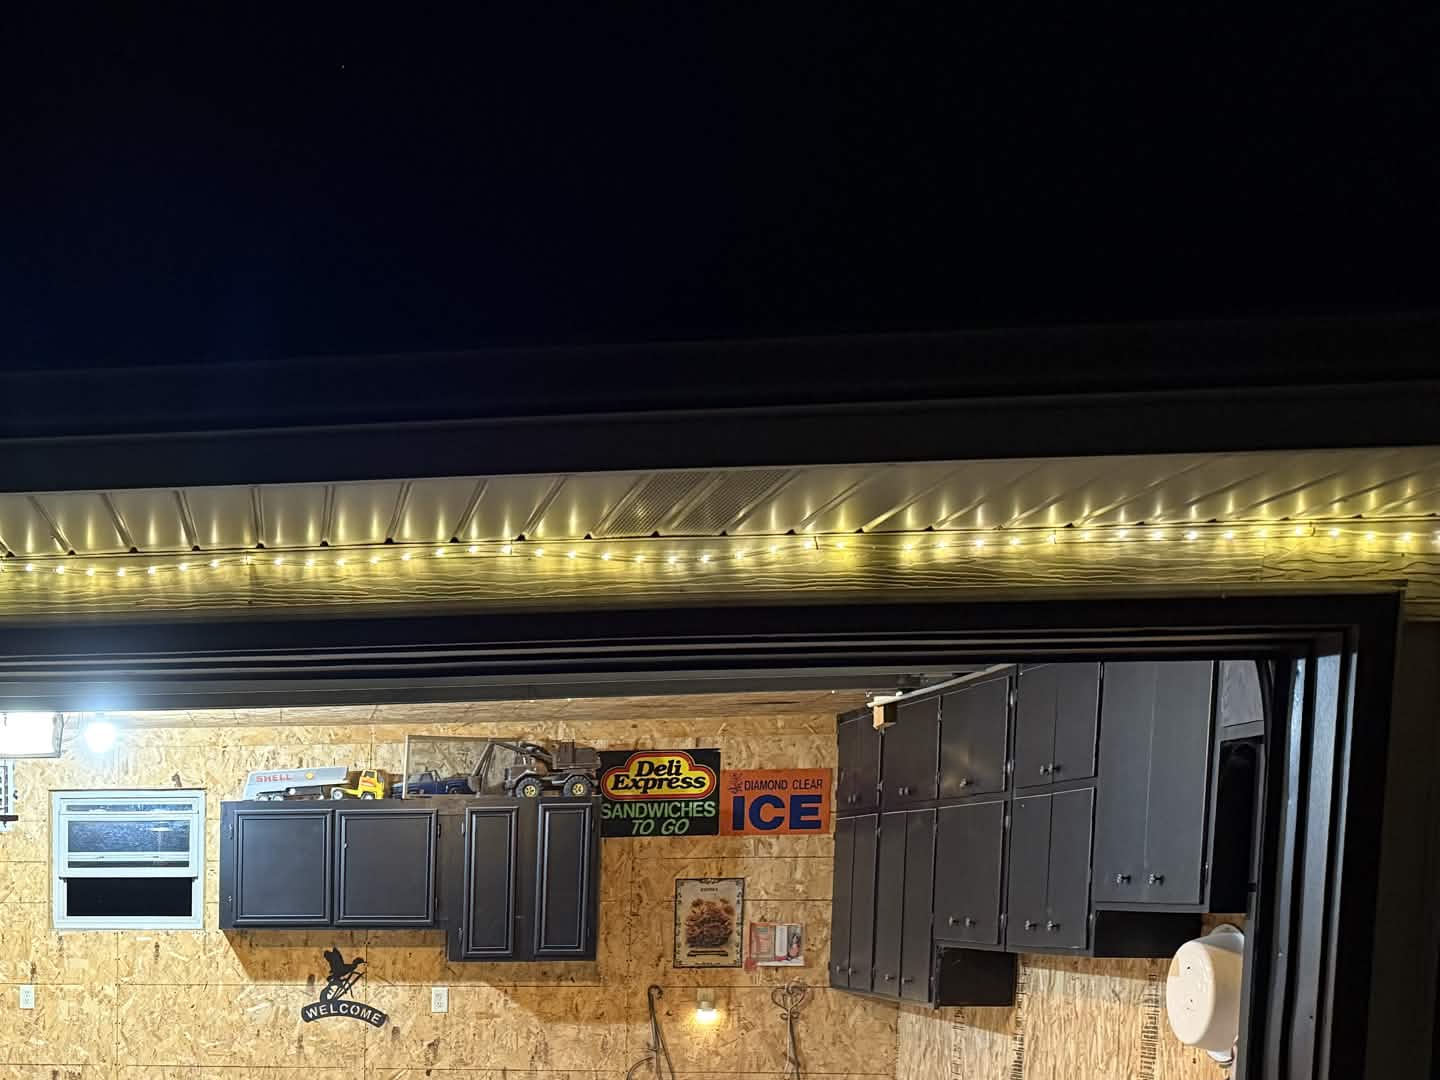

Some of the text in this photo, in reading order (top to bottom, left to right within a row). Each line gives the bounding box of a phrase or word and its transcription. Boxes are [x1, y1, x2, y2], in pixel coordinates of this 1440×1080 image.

[635, 759, 682, 778] Deli
[256, 773, 293, 783] SHELL
[610, 773, 707, 794] Express
[744, 780, 788, 791] DIAMOND
[792, 778, 823, 790] CLEAR
[601, 801, 716, 819] SANDWICHES
[732, 794, 822, 831] ICE
[631, 818, 690, 835] TO GO
[306, 1003, 382, 1024] WELCOME
